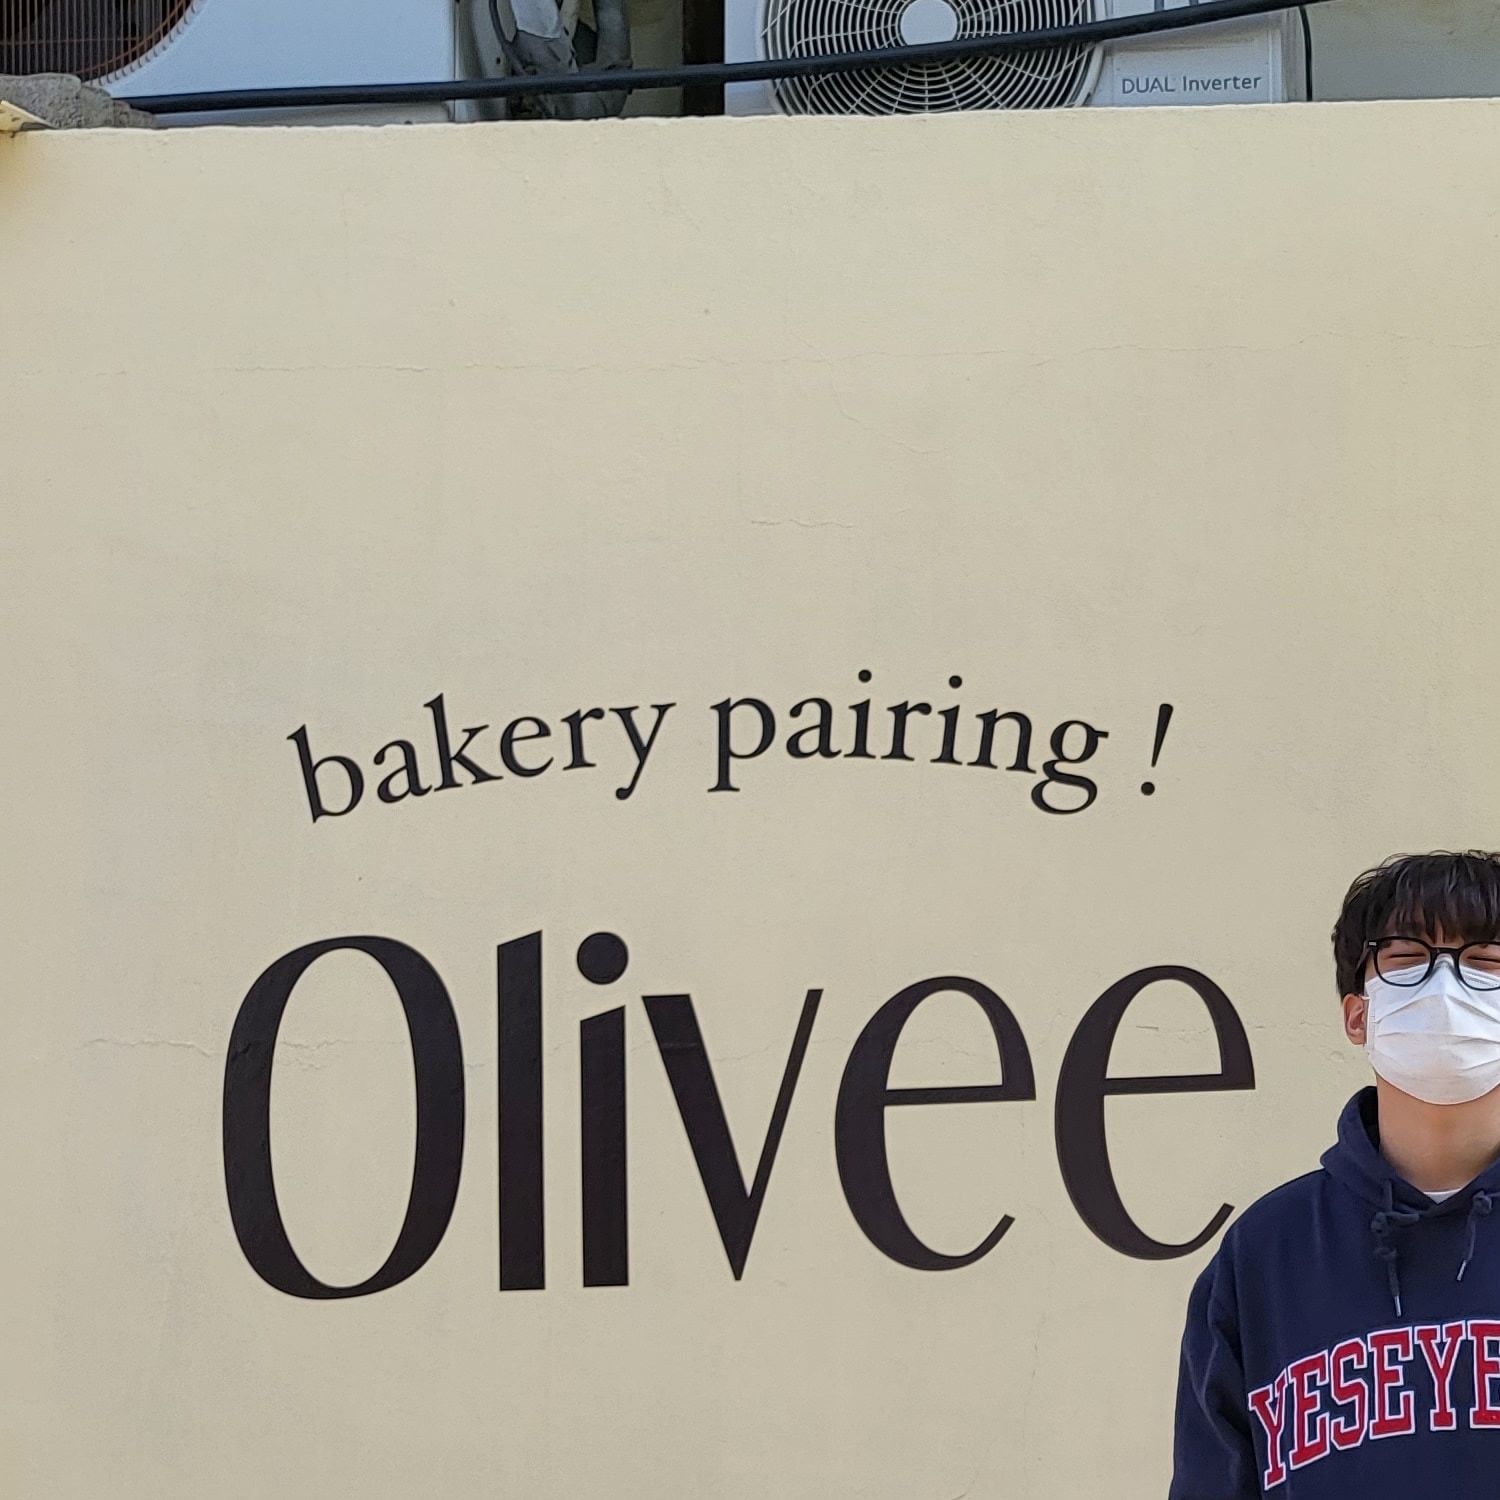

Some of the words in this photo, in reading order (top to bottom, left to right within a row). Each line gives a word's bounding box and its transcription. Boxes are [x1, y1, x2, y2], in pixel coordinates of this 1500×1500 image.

[1122, 76, 1175, 94] DUAL
[1183, 75, 1261, 92] Inverter
[287, 693, 677, 824] bakery
[708, 669, 1109, 815] pairing
[223, 930, 1256, 1301] Olivee
